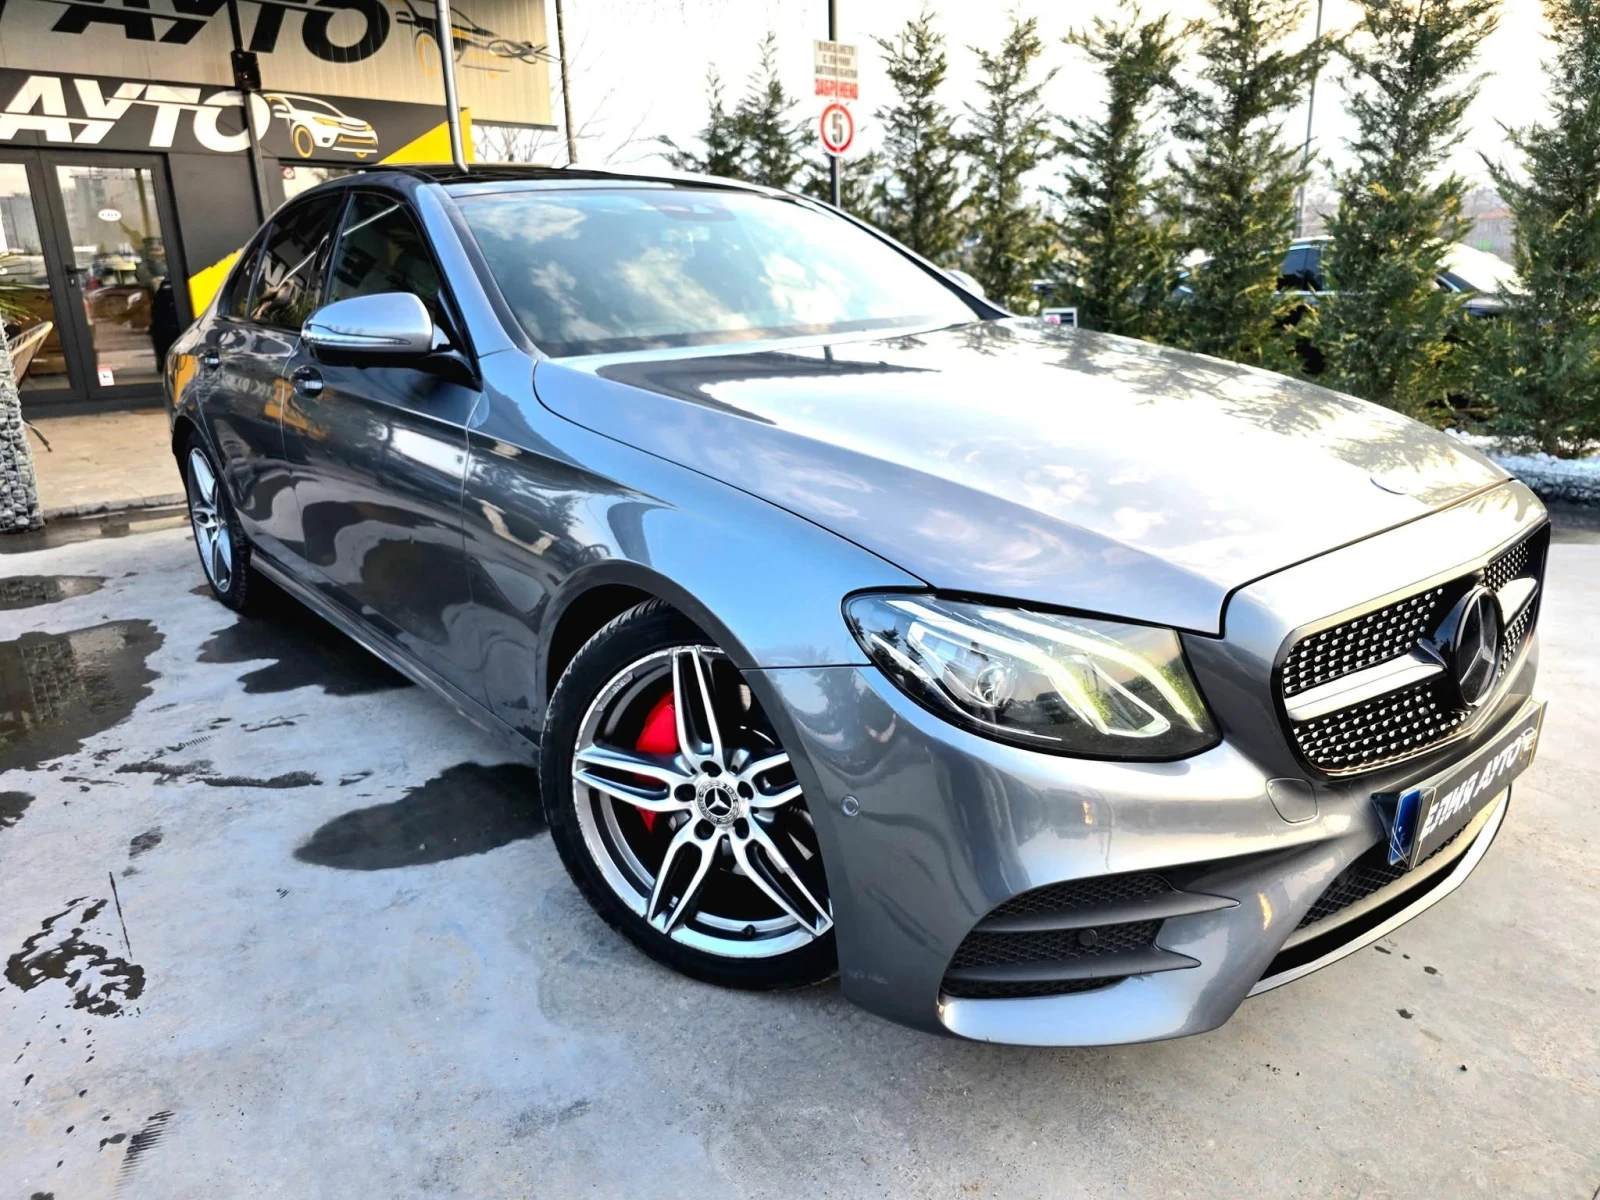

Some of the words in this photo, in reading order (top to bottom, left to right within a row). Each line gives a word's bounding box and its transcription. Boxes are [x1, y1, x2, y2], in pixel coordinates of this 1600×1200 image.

[818, 41, 855, 56] ВЛИЗНЕТО
[815, 65, 858, 79] АВТОМБИЛИ
[0, 75, 271, 153] АУТО
[832, 113, 843, 144] 5
